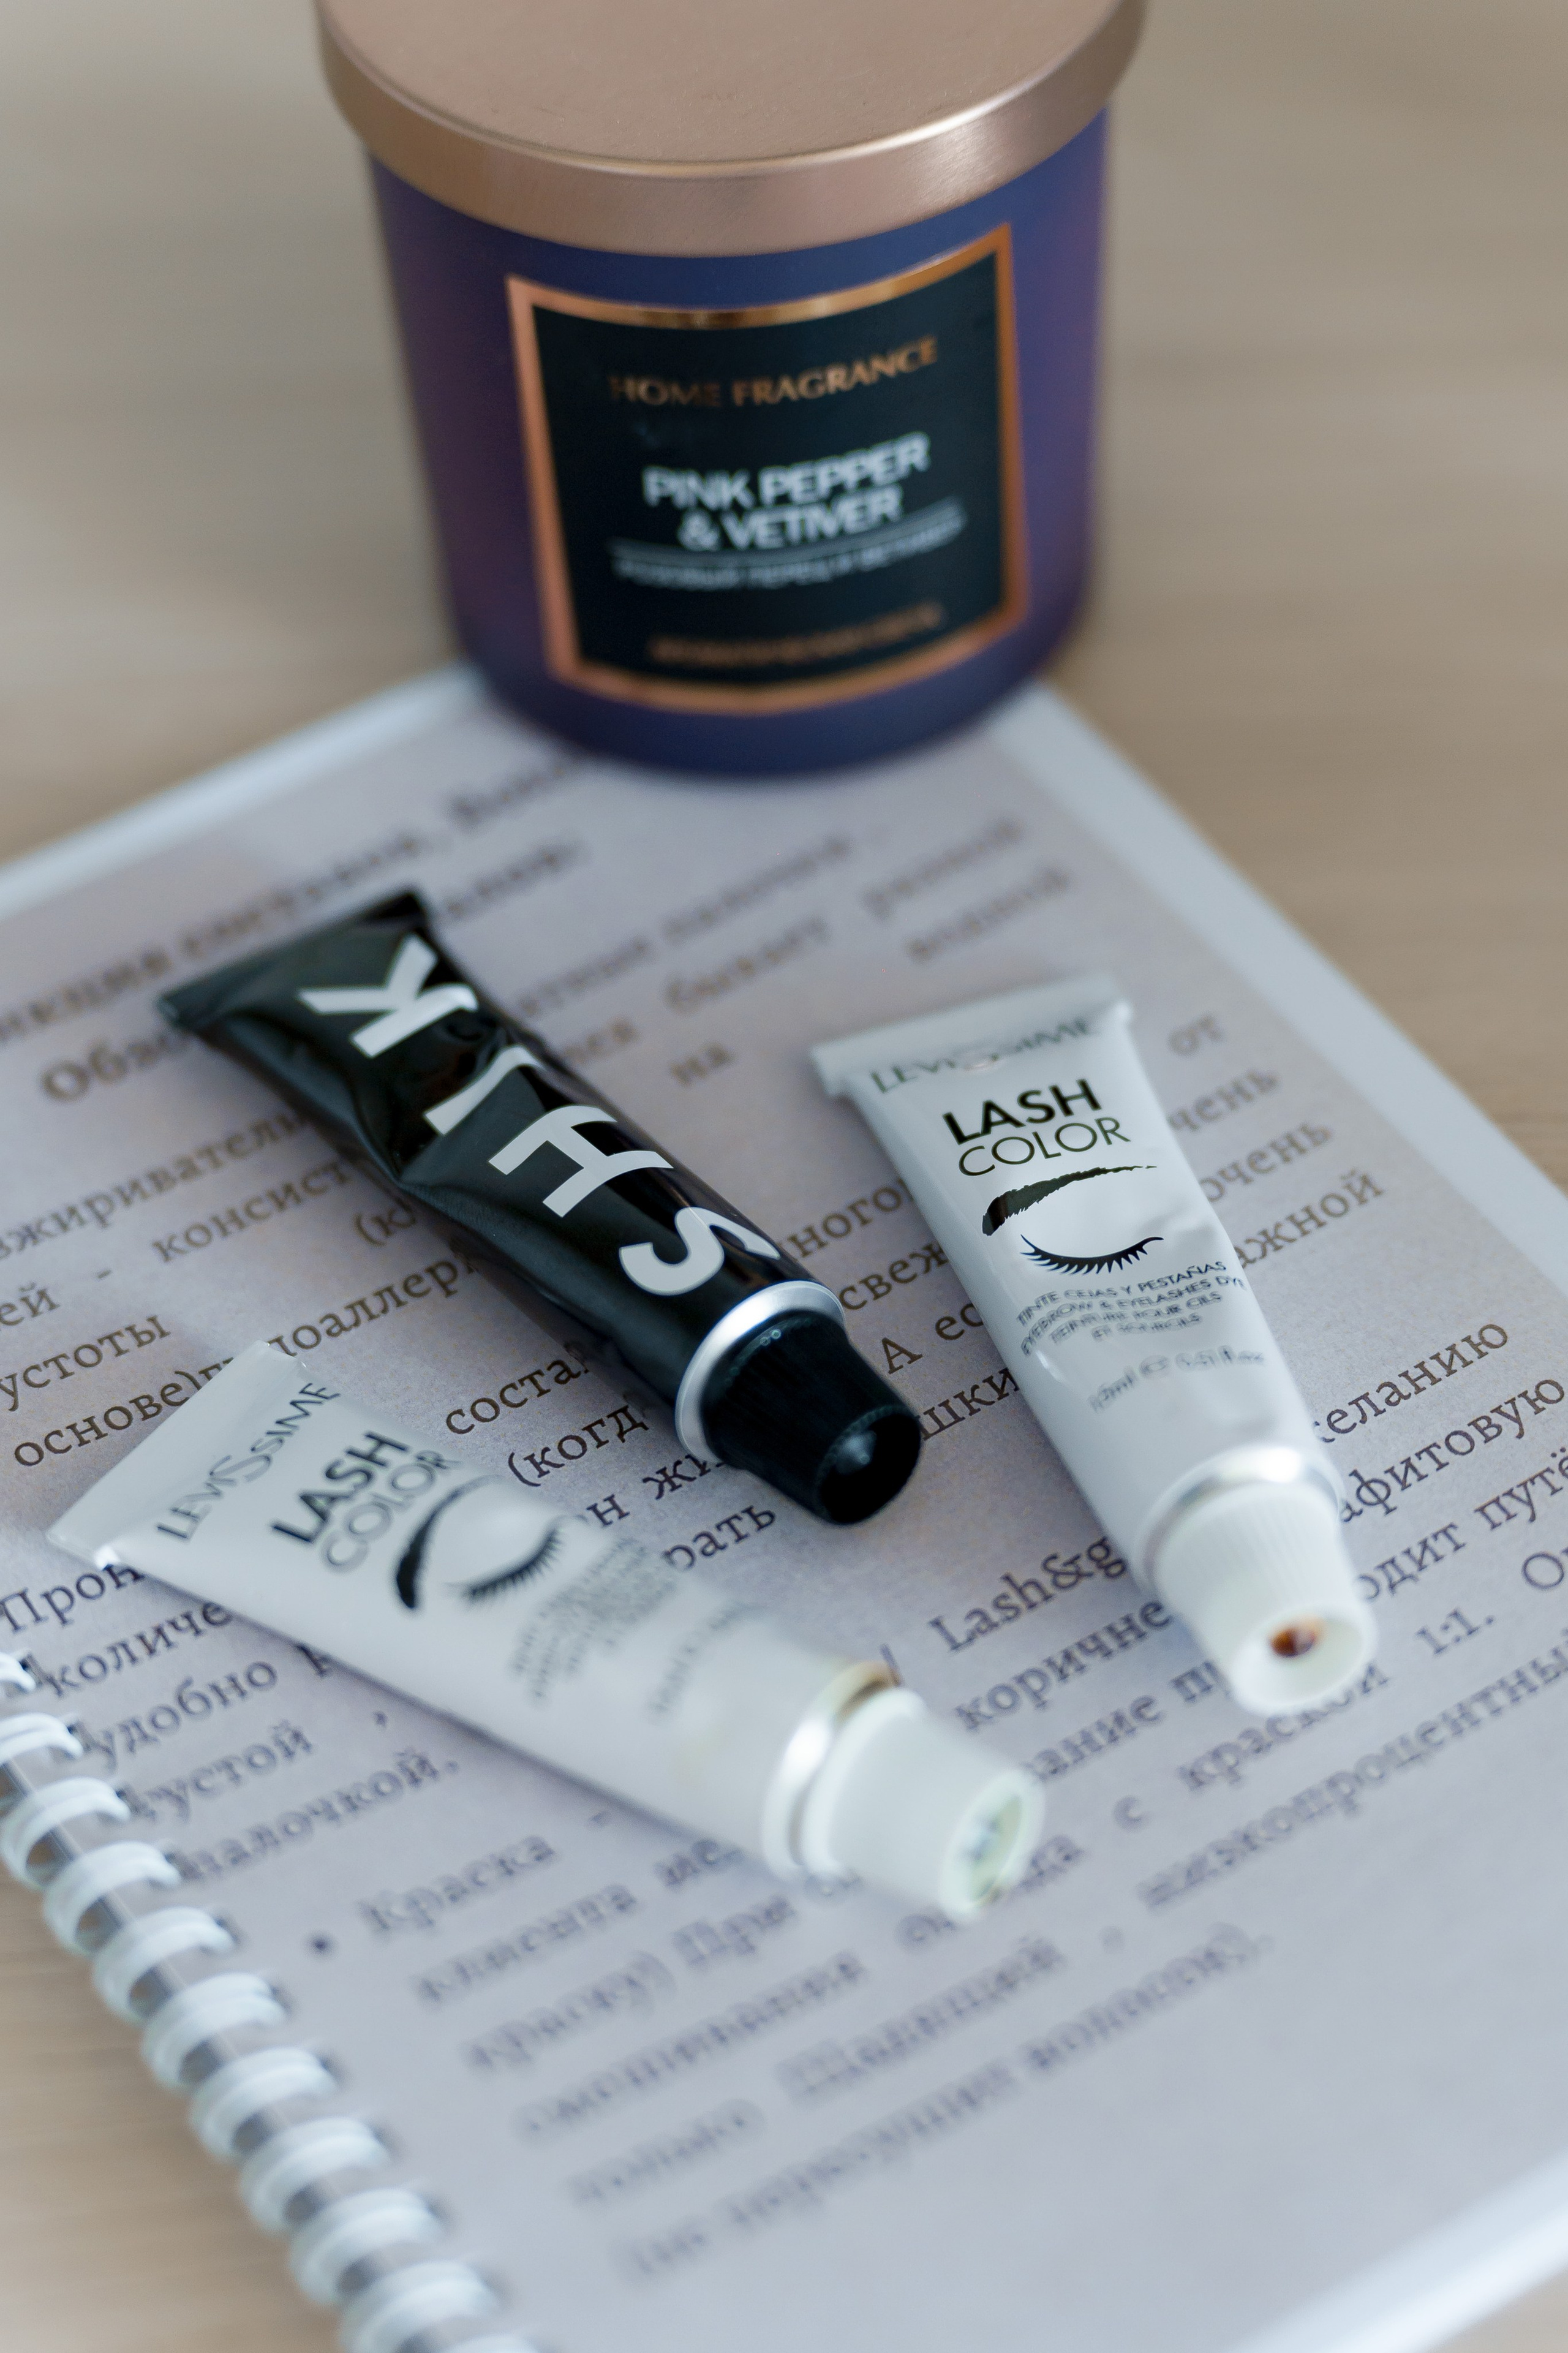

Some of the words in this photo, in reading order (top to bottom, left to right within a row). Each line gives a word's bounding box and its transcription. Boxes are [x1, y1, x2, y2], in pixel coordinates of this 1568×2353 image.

[608, 372, 723, 408] HOME
[733, 336, 940, 407] FRAGRANCE
[642, 466, 753, 510] PINK
[758, 432, 931, 507] PEPPER
[677, 512, 722, 551] &
[722, 485, 903, 550] VETIVER
[942, 1078, 1102, 1146] LASH
[958, 1116, 1132, 1177] COLOR
[1016, 1290, 1060, 1328] TINTE
[1122, 1285, 1133, 1296] Y
[1137, 1261, 1227, 1293] PESTAÑAS
[880, 1337, 923, 1375] А
[445, 1359, 589, 1435] соста
[270, 1430, 411, 1546] LASH
[320, 1448, 458, 1574] COLOR
[1137, 1626, 1568, 1909] низкопроцентны
